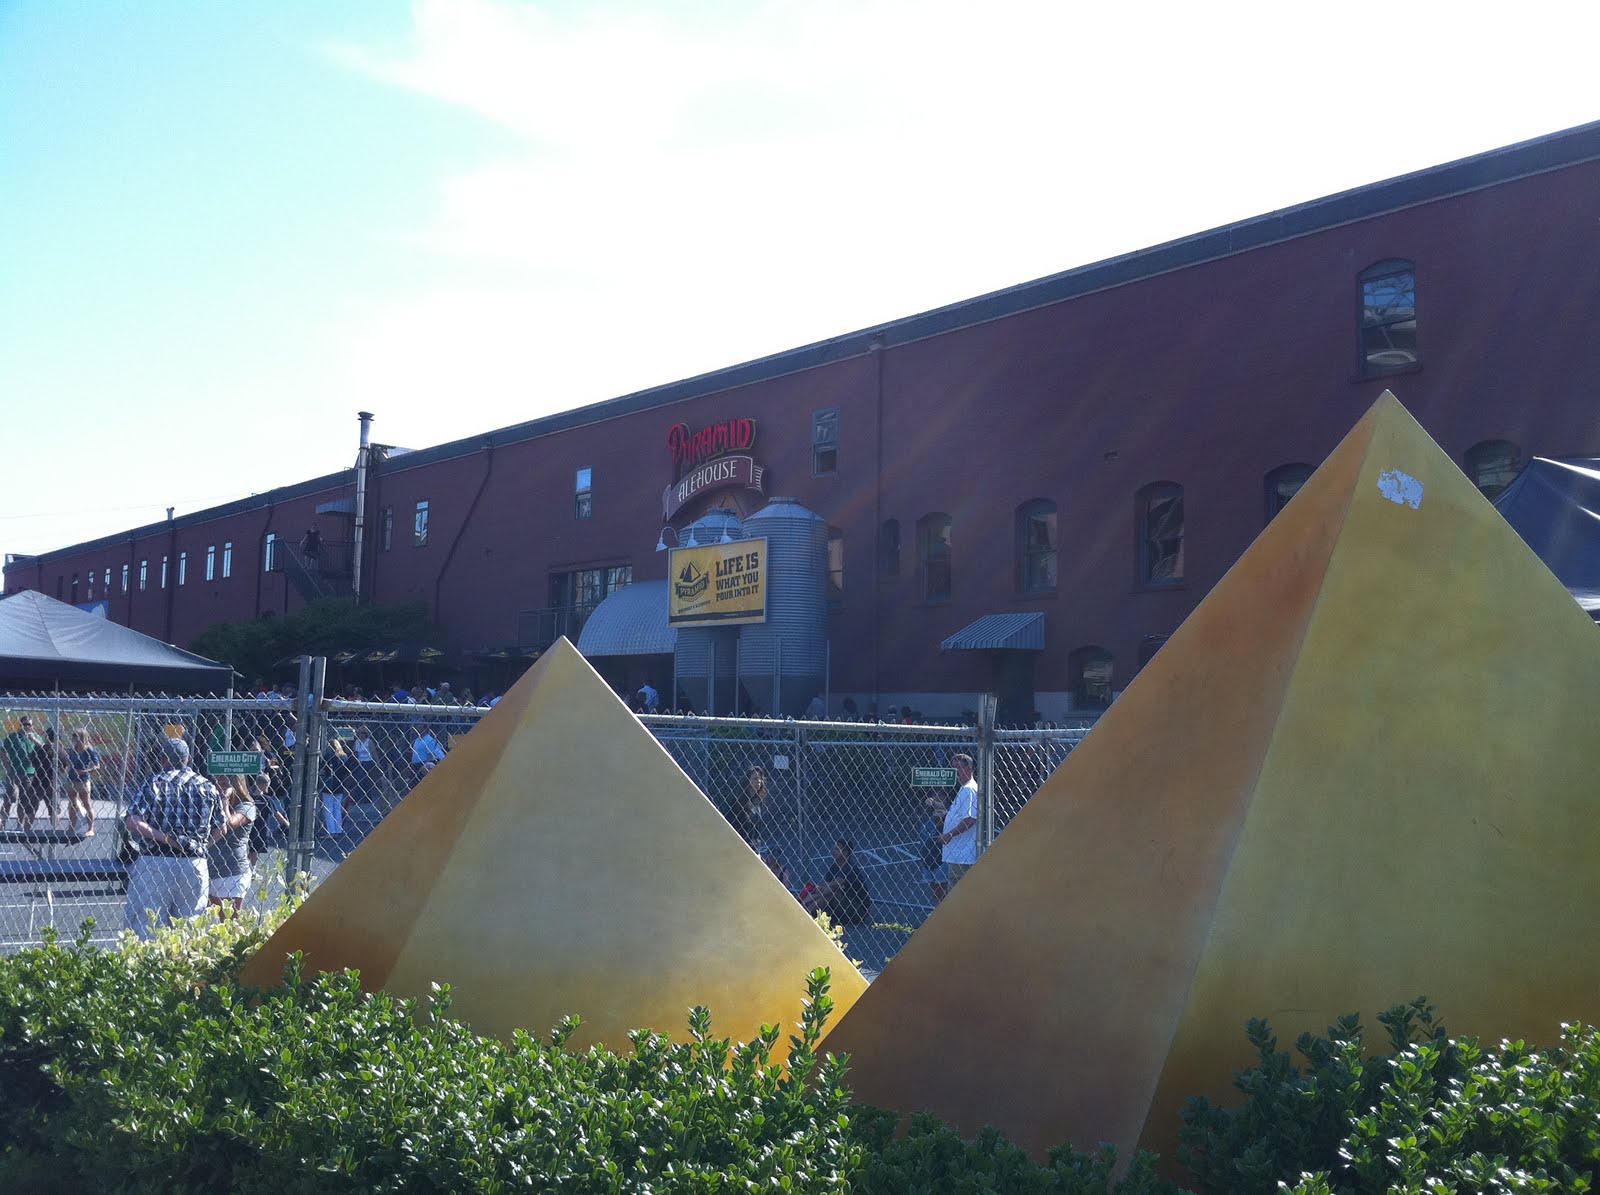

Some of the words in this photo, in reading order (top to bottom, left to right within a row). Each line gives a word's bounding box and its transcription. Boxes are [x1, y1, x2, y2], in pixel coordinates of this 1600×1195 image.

[667, 418, 752, 464] PYRAMID
[678, 459, 738, 502] ALEHOUSE
[715, 556, 744, 578] LIFE
[745, 551, 759, 570] IS
[680, 580, 706, 597] PYRAMID
[715, 574, 741, 591] WHAT
[742, 571, 759, 585] YOU
[715, 591, 734, 602] POUR
[734, 587, 750, 599] INTO
[751, 584, 760, 594] IT
[211, 753, 241, 763] EMERALD
[242, 753, 258, 763] CITY
[915, 769, 940, 777] EMERALD
[940, 769, 954, 778] CITY
